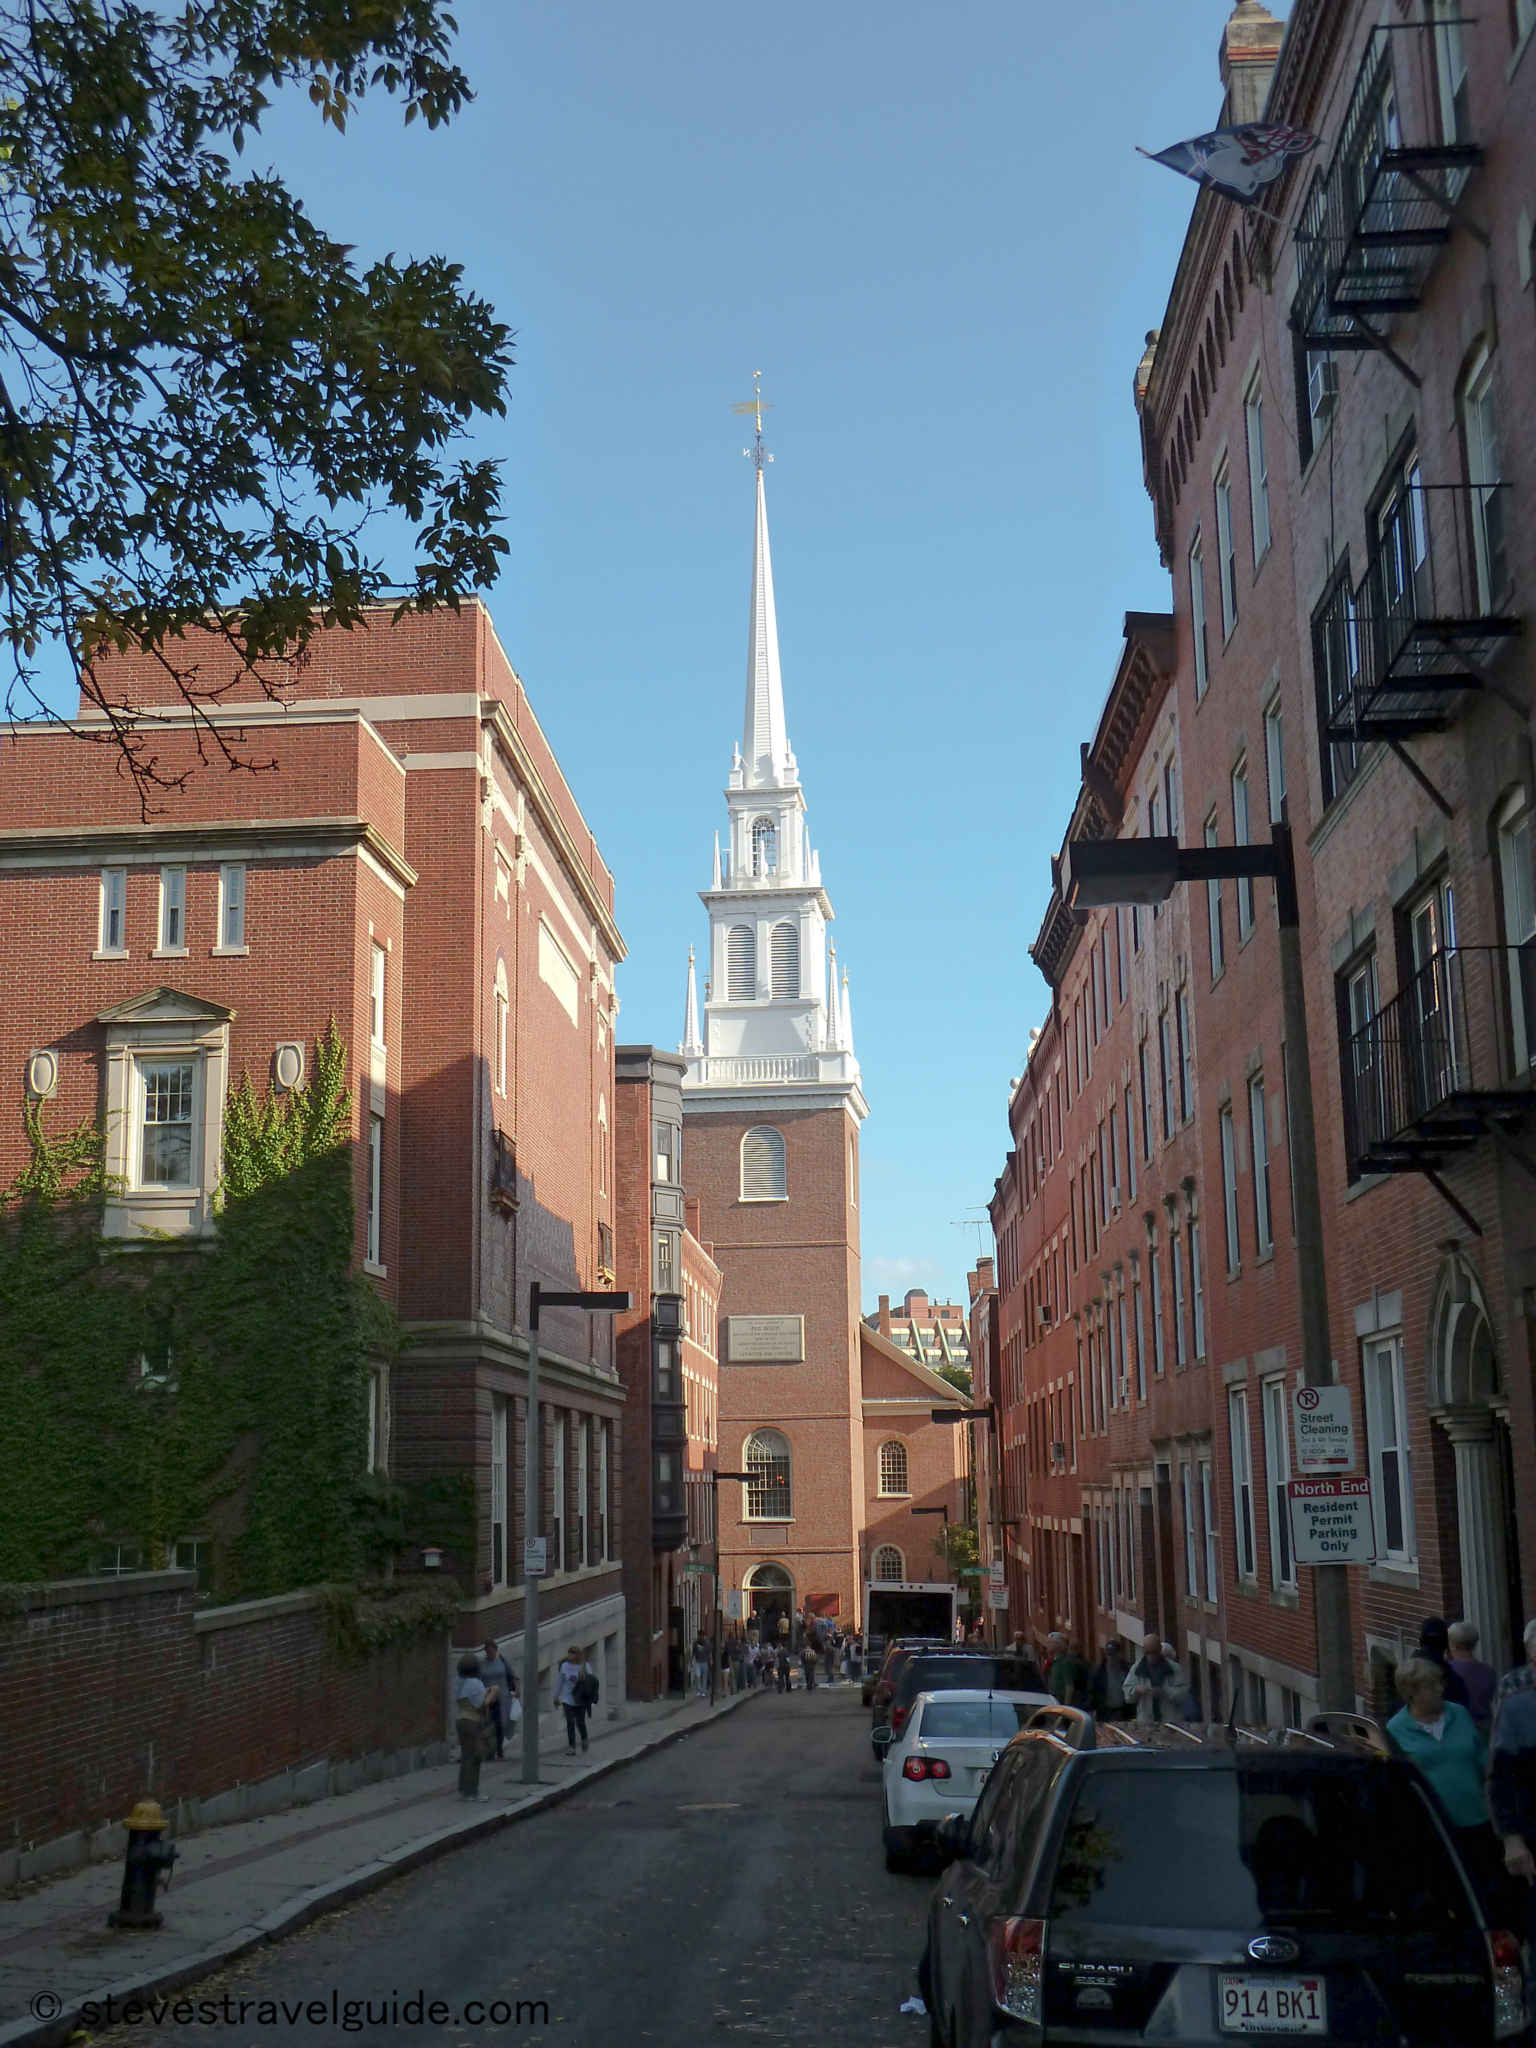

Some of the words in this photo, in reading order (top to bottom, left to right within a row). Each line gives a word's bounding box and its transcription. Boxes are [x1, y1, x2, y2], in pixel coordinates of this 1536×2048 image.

[1300, 1413, 1334, 1424] Street
[1300, 1424, 1349, 1436] Cleaning
[1294, 1481, 1335, 1496] North
[1340, 1479, 1369, 1494] End
[1303, 1501, 1359, 1514] Resident
[1311, 1514, 1353, 1526] Permit
[1309, 1527, 1358, 1540] Parking
[1320, 1540, 1350, 1553] Only
[1225, 1989, 1269, 2018] 914
[1276, 1990, 1321, 2020] BK1
